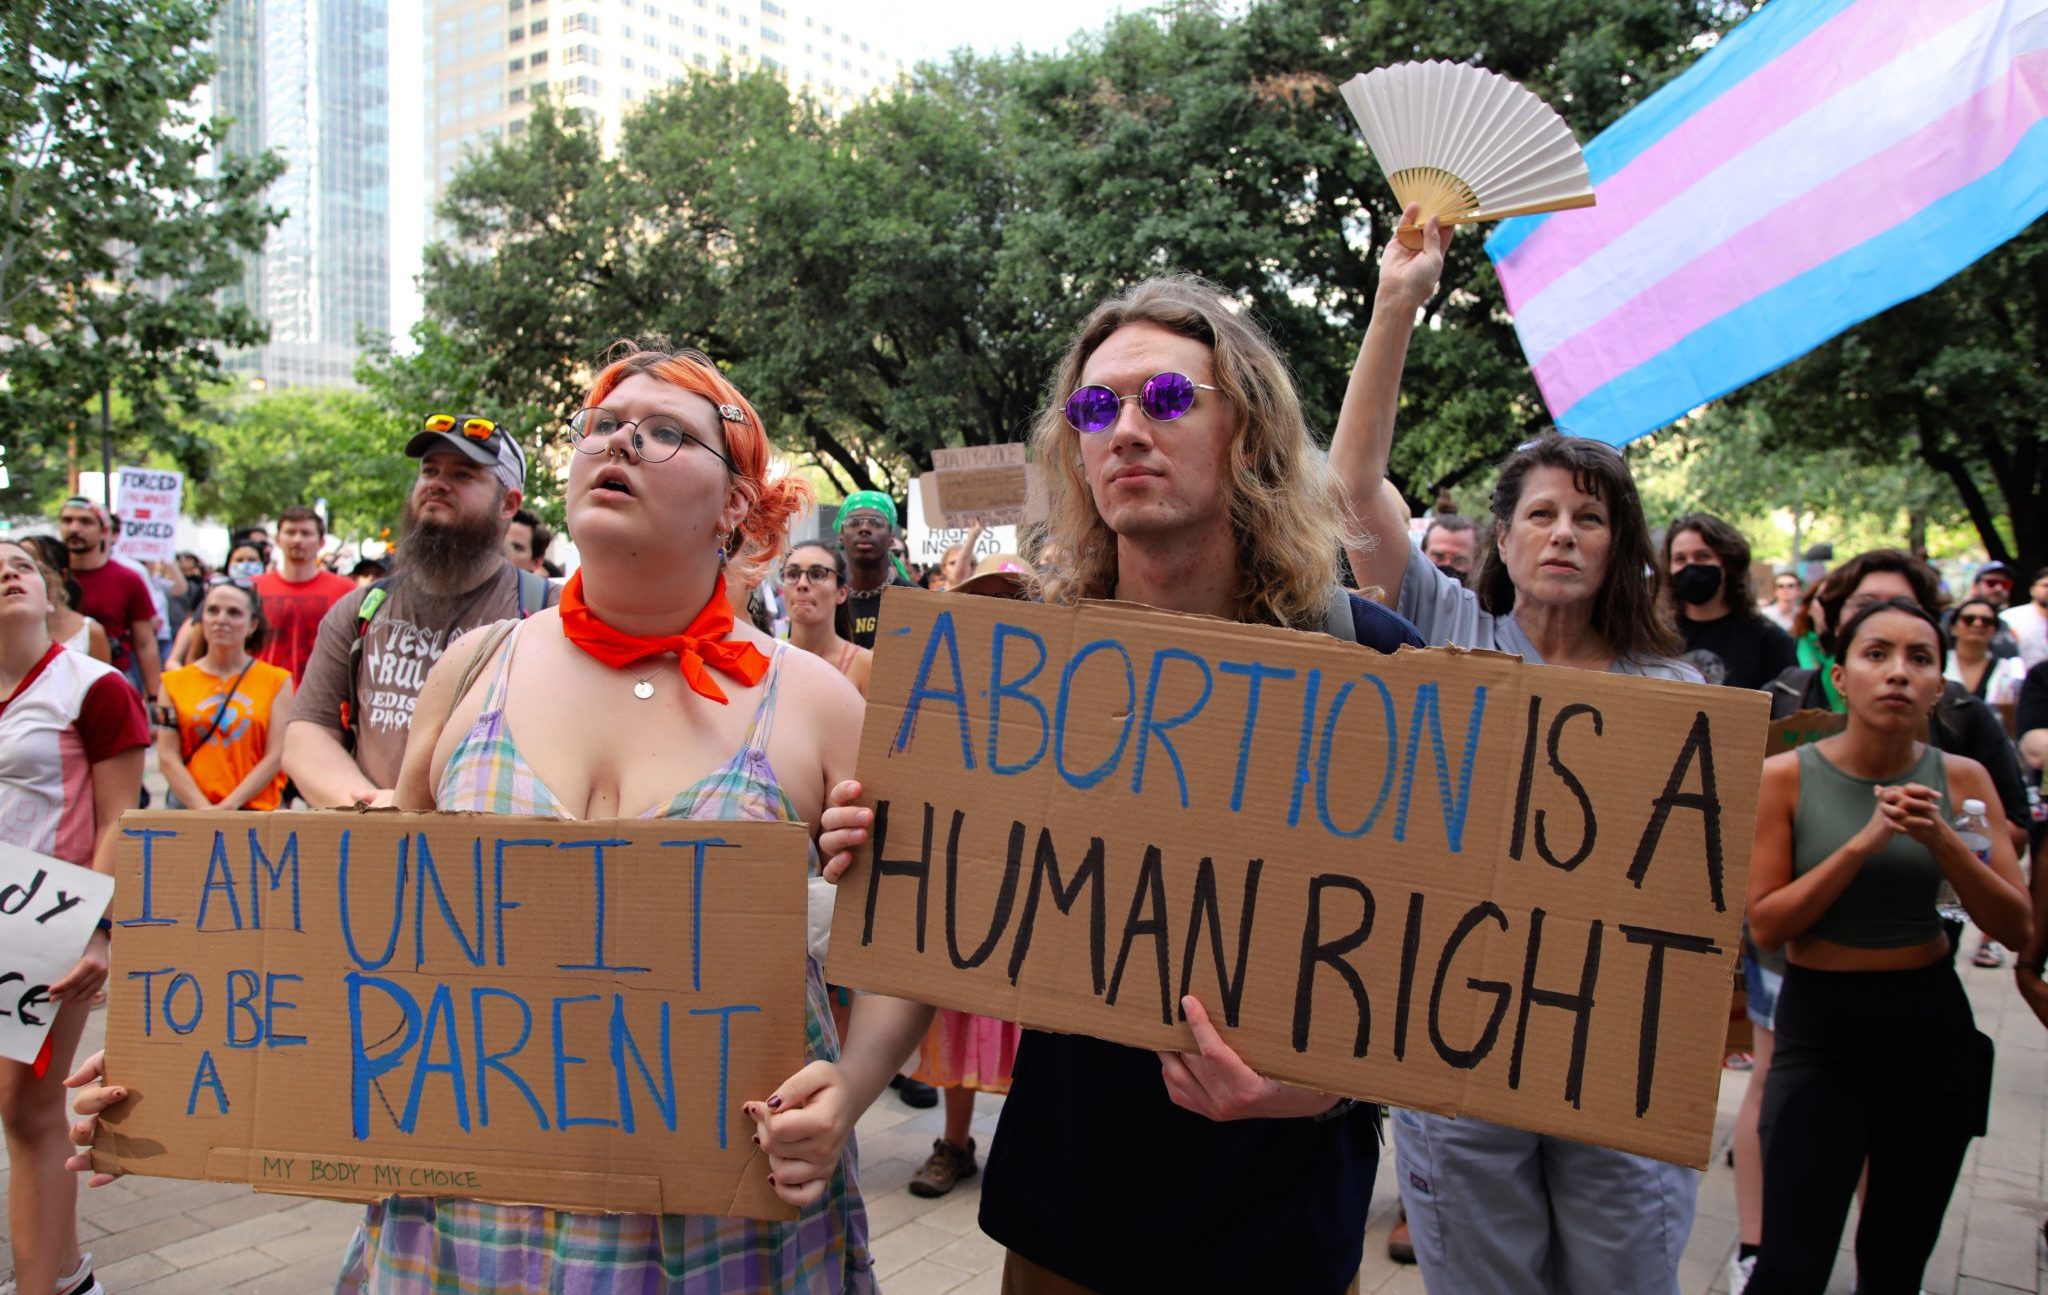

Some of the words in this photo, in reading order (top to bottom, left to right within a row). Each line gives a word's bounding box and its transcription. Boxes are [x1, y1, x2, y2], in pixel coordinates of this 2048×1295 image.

[122, 473, 177, 491] FORCED
[120, 521, 174, 539] ORCED
[922, 540, 1002, 555] INSAD
[928, 526, 995, 540] RIGHS
[377, 653, 431, 691] RUL
[371, 691, 418, 711] EDIS
[888, 611, 1487, 853] ABORTION
[1509, 695, 1604, 872] IS
[1626, 711, 1728, 913] A
[116, 828, 178, 926] I
[196, 828, 302, 931] AM
[338, 829, 741, 992] UNFIT
[862, 800, 1264, 1028] HUMAN
[1292, 873, 1723, 1118] RIGHT
[128, 967, 203, 1037] TO
[223, 968, 308, 1049] BE
[344, 971, 761, 1150] PARENT
[186, 1050, 230, 1115] A
[263, 1156, 295, 1179] MY
[310, 1160, 361, 1184] BODY
[374, 1164, 402, 1185] MY
[410, 1168, 481, 1188] CHOICE
